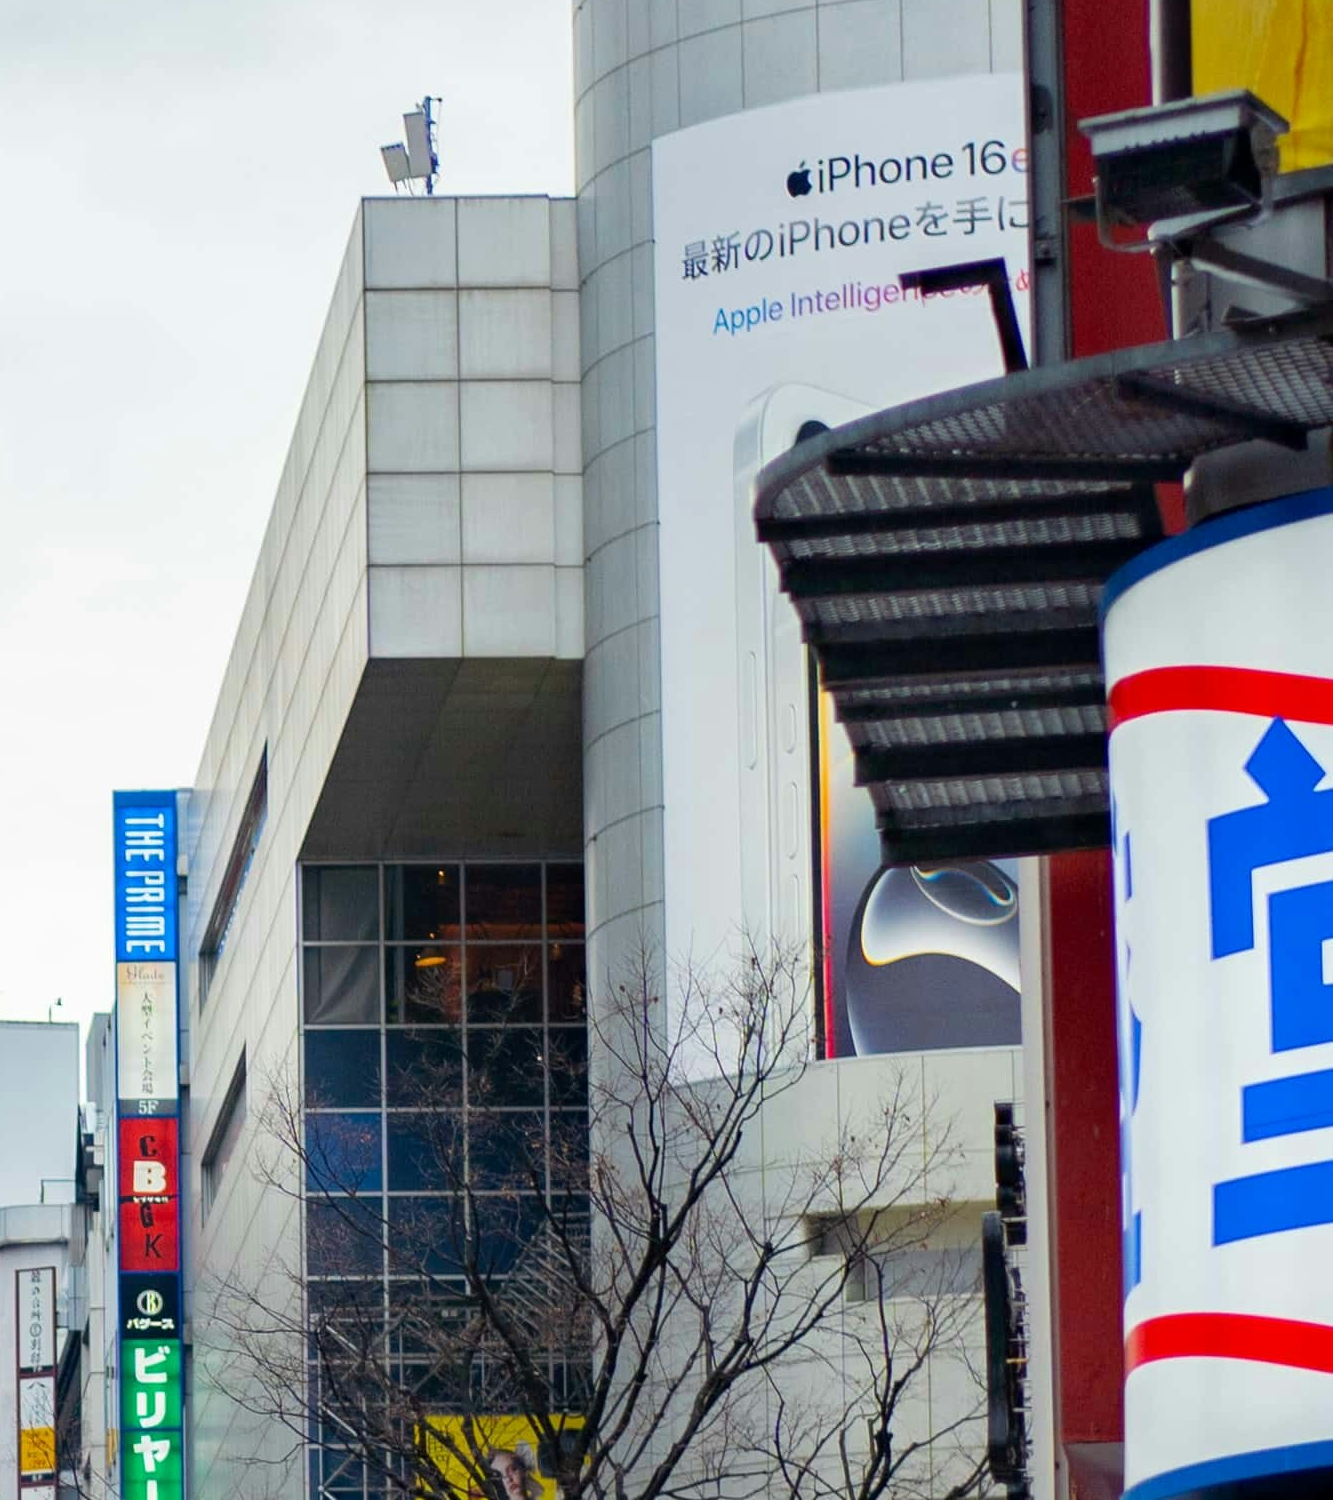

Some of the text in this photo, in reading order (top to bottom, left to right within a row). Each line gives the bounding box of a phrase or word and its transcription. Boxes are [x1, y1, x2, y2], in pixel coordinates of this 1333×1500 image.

[817, 151, 954, 195] iPhone
[713, 296, 783, 336] Apple
[124, 813, 165, 860] THE
[125, 868, 166, 955] PRIME
[138, 1100, 159, 1115] 5F
[126, 1317, 175, 1330] バグース
